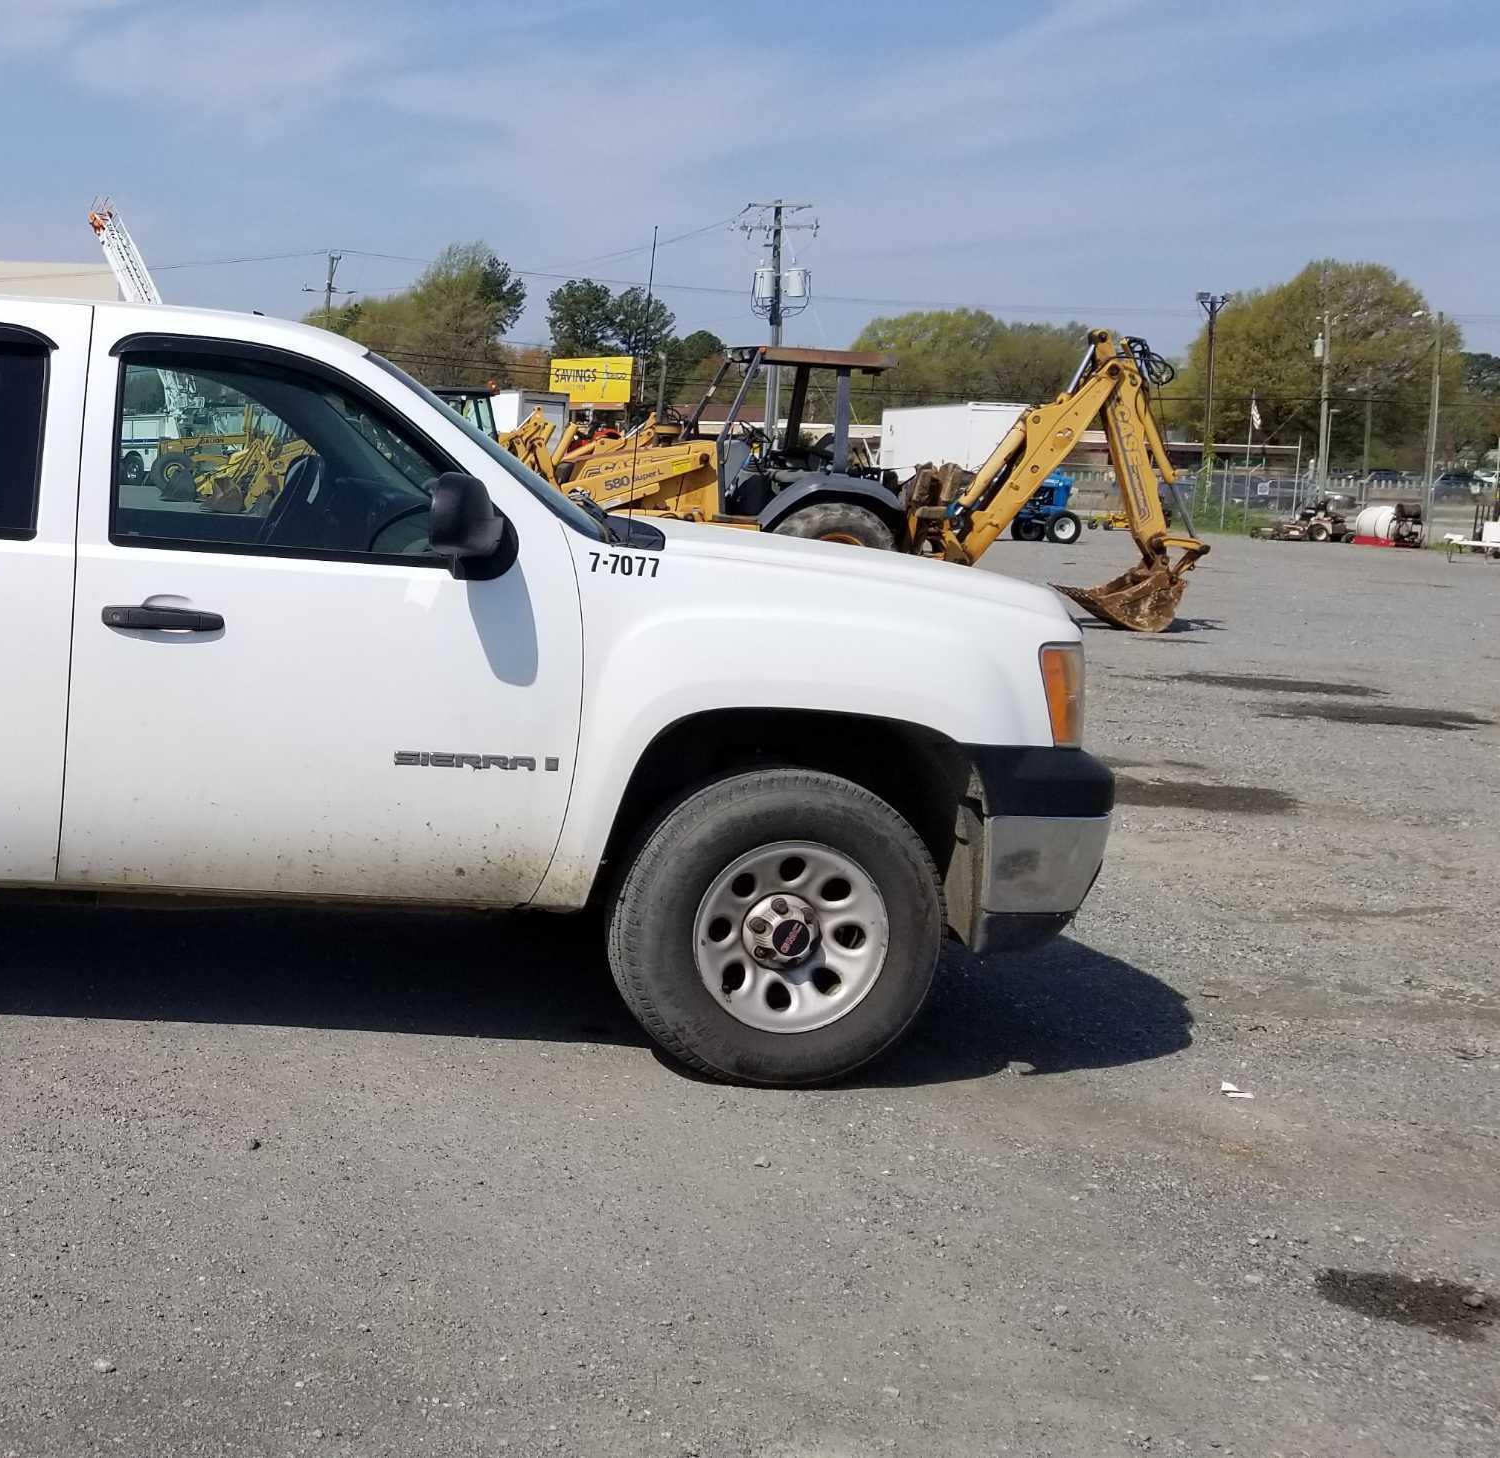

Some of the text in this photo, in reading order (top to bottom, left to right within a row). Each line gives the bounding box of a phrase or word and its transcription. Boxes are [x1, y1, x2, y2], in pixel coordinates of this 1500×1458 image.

[554, 368, 597, 383] SAVINGS
[1114, 403, 1141, 465] CASE
[604, 475, 630, 491] 580
[589, 552, 660, 578] 7-7077
[394, 751, 536, 772] SIERRA
